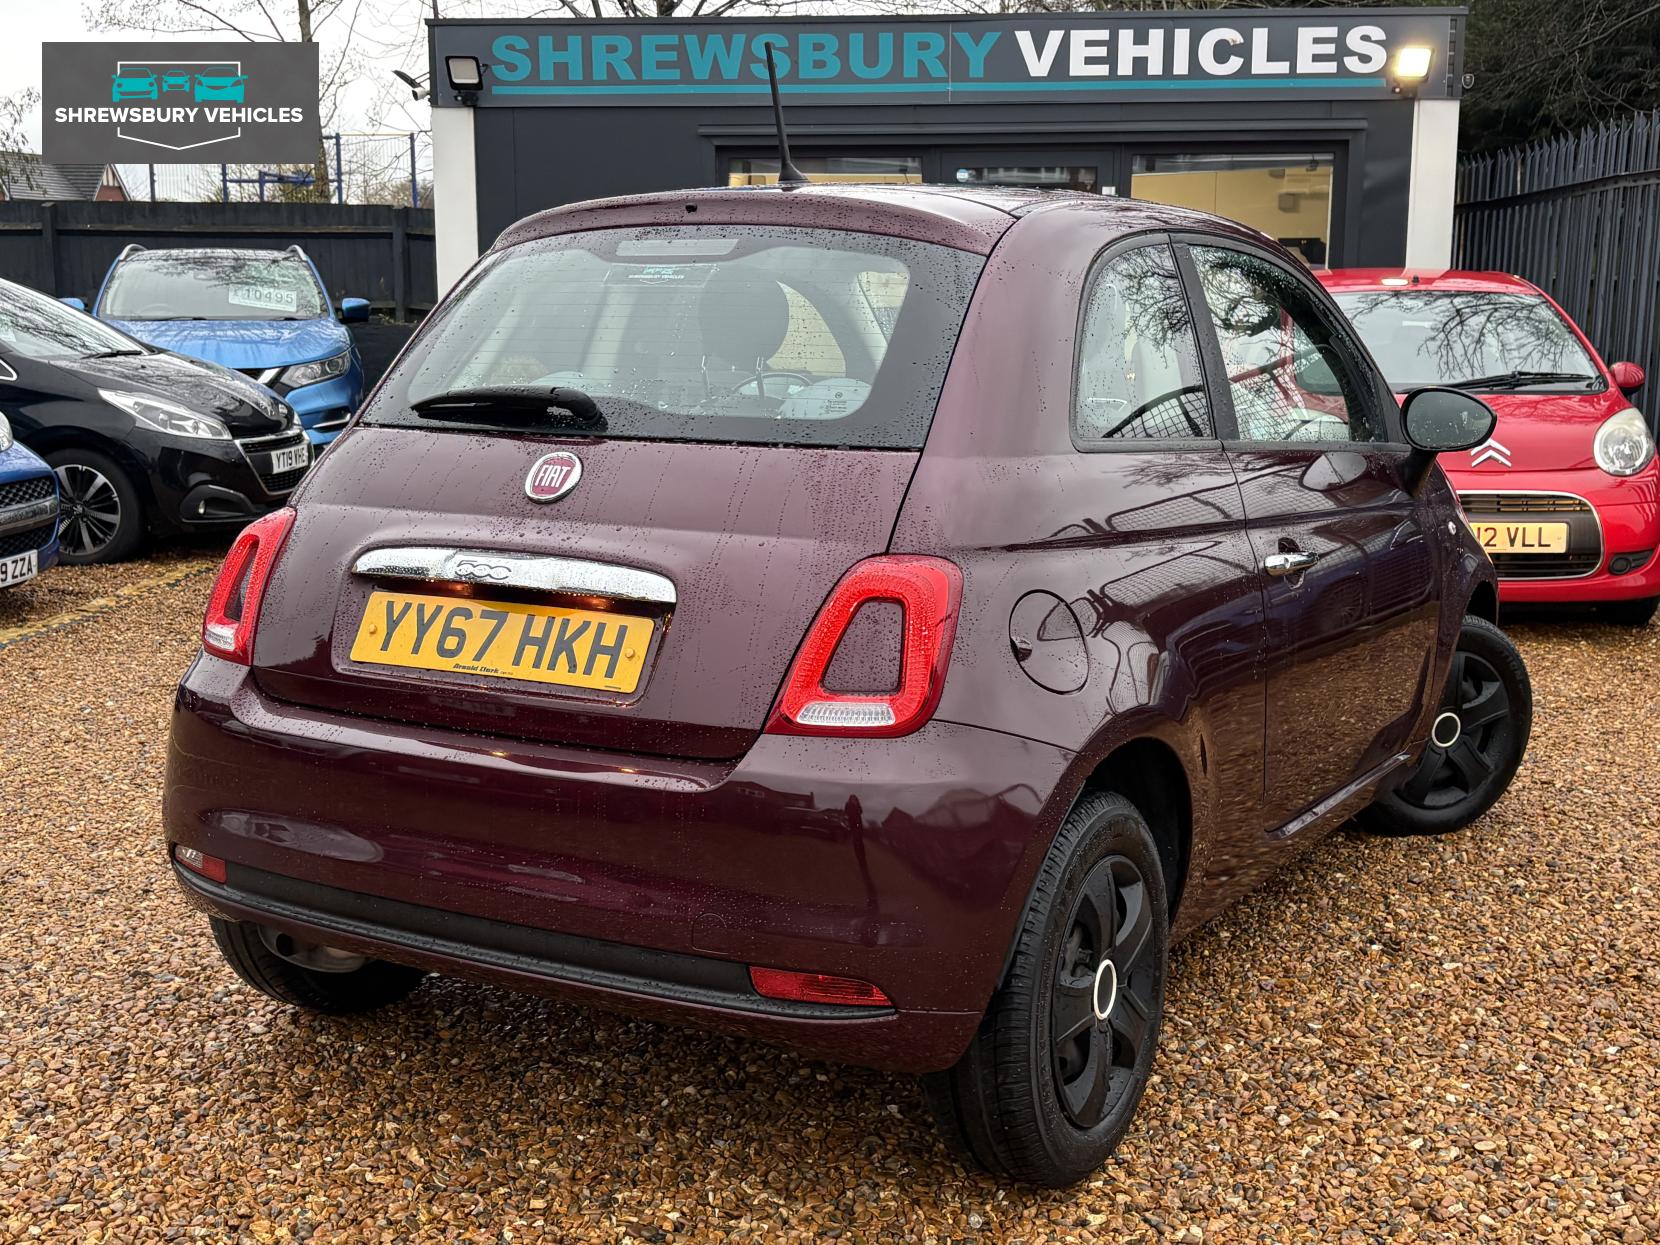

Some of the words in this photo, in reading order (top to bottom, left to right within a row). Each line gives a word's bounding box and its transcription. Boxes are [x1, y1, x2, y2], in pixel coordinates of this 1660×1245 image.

[491, 31, 1001, 82] SHREWSBURY
[1014, 25, 1388, 77] VEHICLES
[276, 450, 293, 469] YT19
[534, 464, 572, 488] FIAT
[1506, 527, 1551, 547] VLL
[11, 553, 33, 580] ZZA
[455, 560, 512, 580] 500
[380, 601, 509, 662] YY67
[511, 613, 628, 679] HKH
